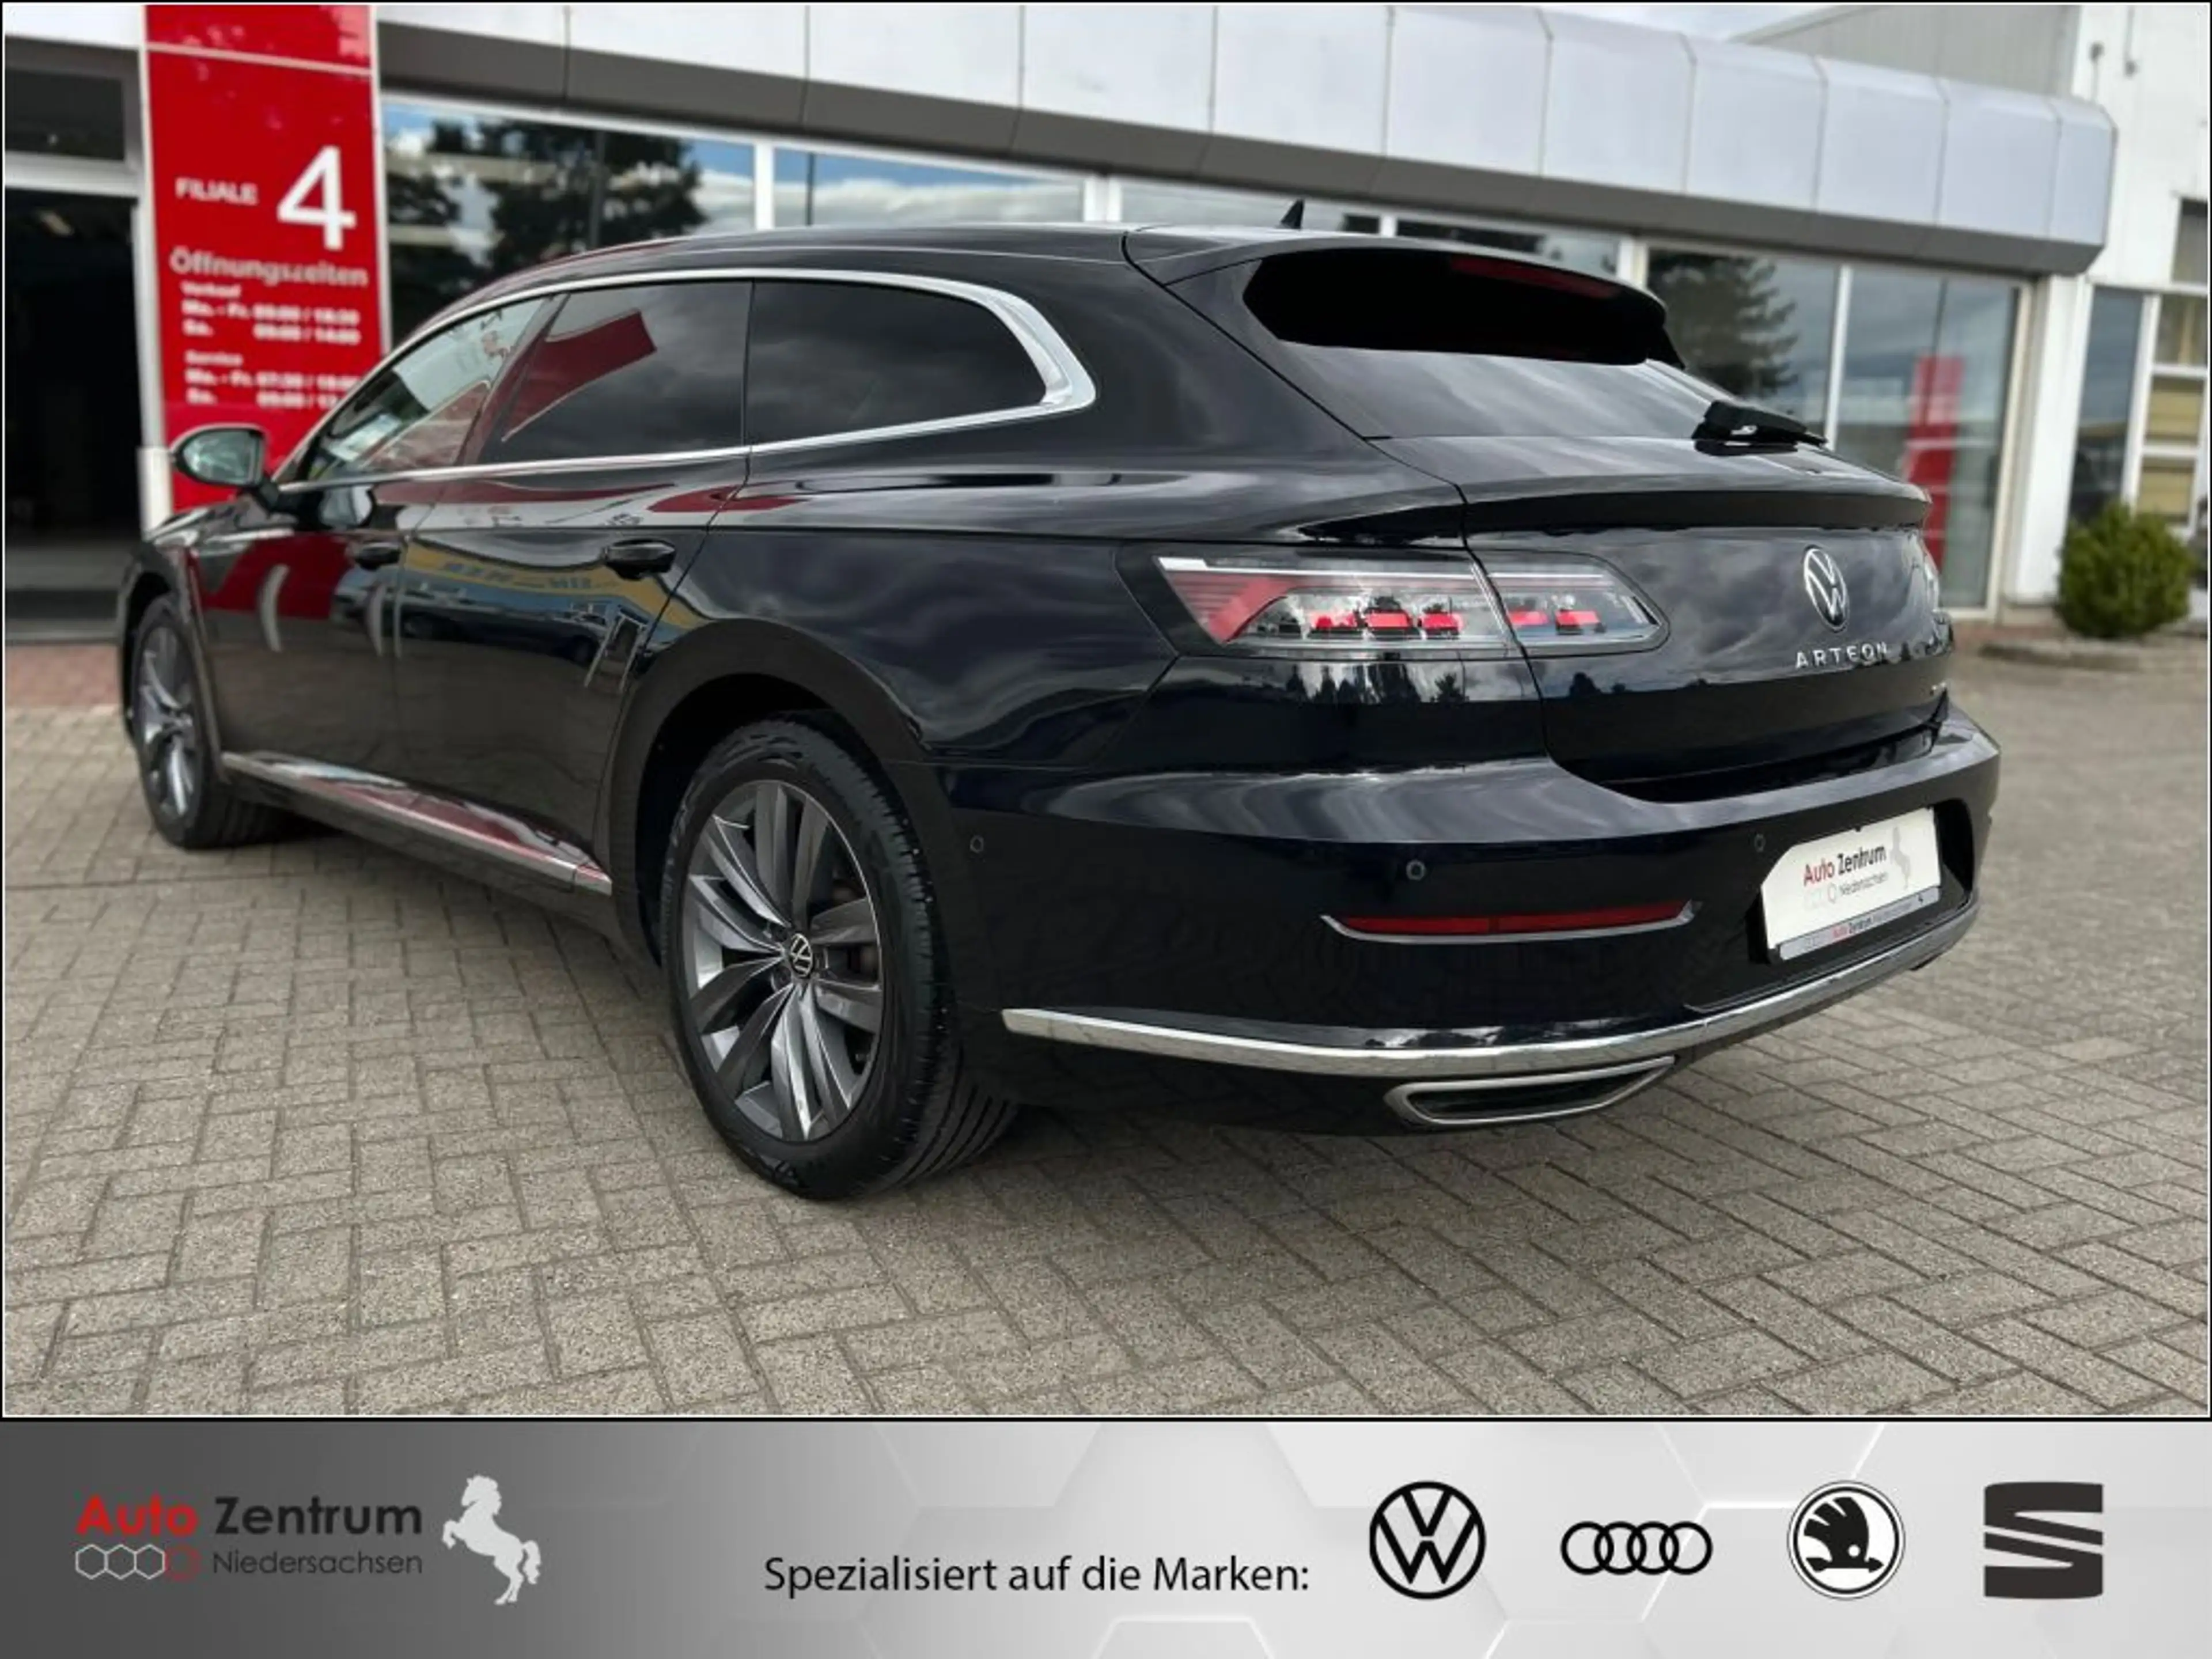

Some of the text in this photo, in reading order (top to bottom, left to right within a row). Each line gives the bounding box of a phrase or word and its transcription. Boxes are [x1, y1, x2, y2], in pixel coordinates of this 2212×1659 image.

[175, 146, 357, 251] FILIALE 4
[170, 246, 369, 287] Öffnungszeiten
[1796, 641, 1889, 668] ARTEON
[1804, 845, 1887, 887] Auto Zentrum
